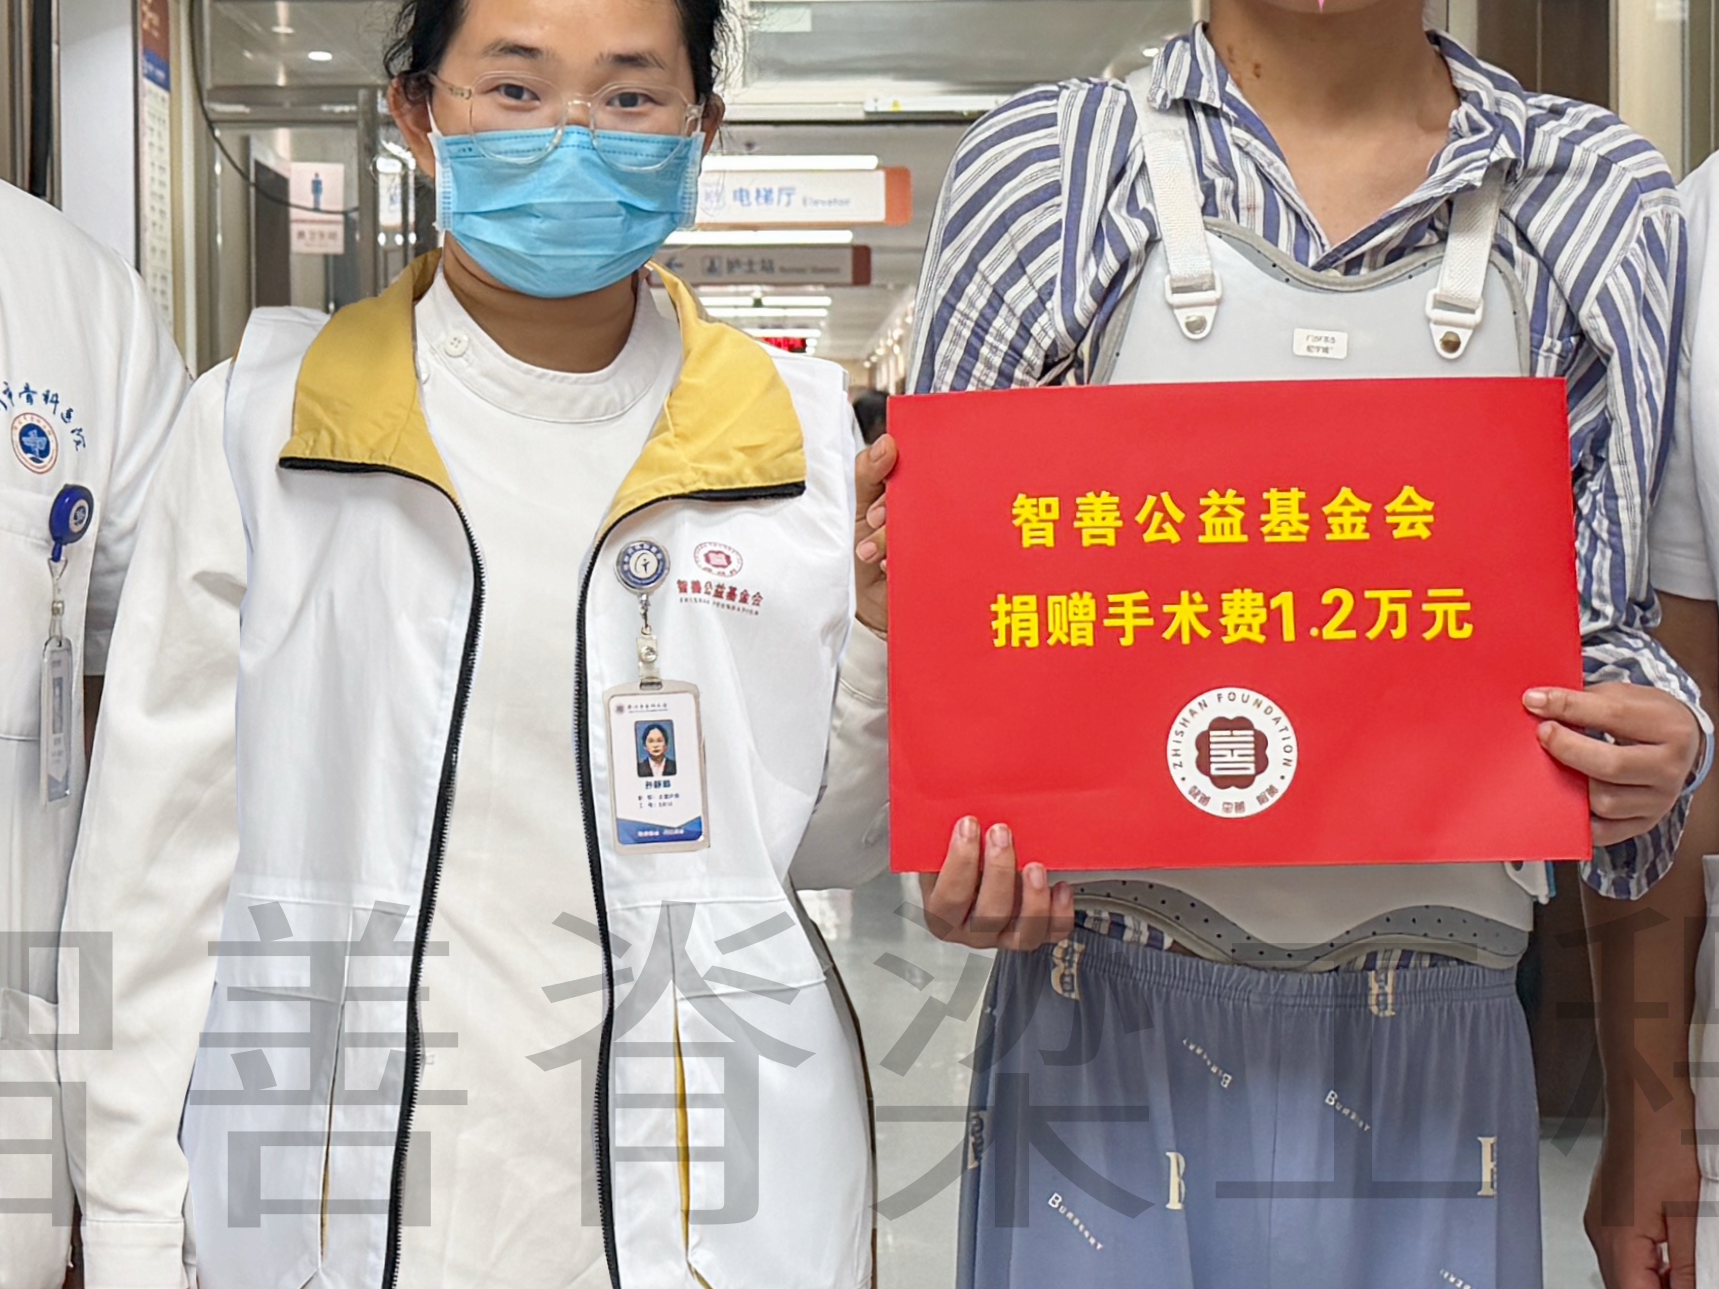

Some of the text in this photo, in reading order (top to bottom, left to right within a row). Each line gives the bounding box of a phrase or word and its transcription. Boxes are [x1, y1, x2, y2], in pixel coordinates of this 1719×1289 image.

[732, 186, 797, 208] 电梯厅
[726, 258, 776, 275] 护士站
[1010, 485, 1437, 549] 智善公益基金会
[989, 586, 1474, 649] 捐赠手术费1.2万元
[1171, 691, 1294, 770] ZHISHAN FOUNDATION
